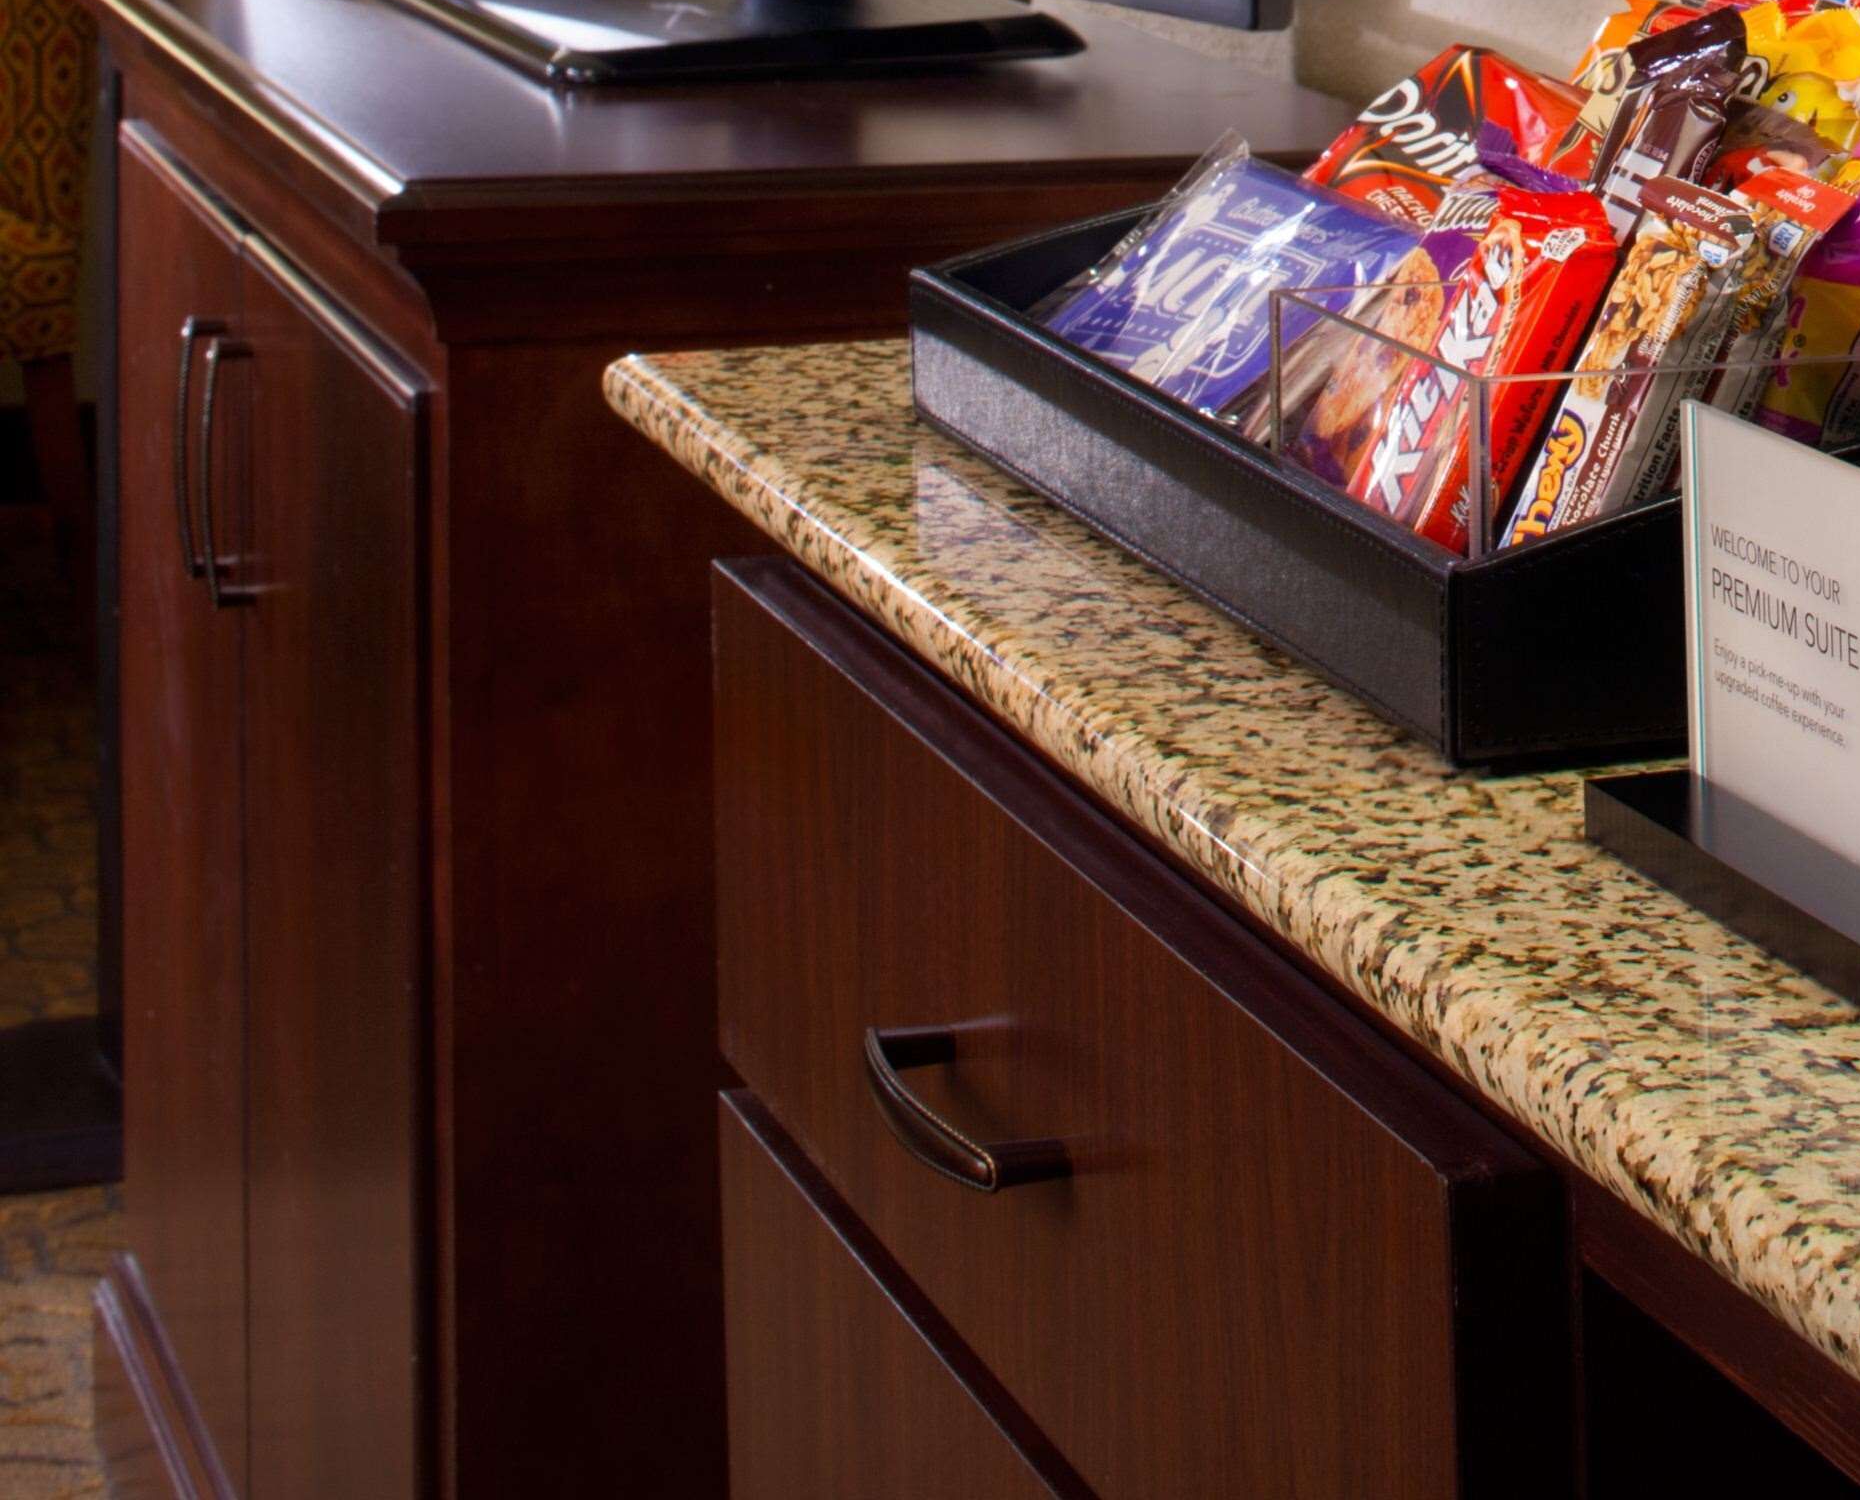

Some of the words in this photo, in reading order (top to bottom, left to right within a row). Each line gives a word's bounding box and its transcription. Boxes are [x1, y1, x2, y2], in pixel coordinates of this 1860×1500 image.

[1357, 78, 1480, 179] Dorit
[1387, 185, 1434, 228] NACHO
[1568, 462, 1601, 525] hocolate
[1597, 412, 1622, 465] Chunk
[1632, 452, 1662, 501] trition
[1655, 408, 1681, 453] Facts
[1711, 523, 1777, 576] WELCOME
[1780, 555, 1800, 585] TO
[1802, 566, 1841, 604] YOUR
[1712, 567, 1798, 640] PREMIUM
[1805, 612, 1860, 671] SUITE
[1714, 637, 1738, 669] Enjoy
[1739, 657, 1746, 669] a
[1748, 659, 1800, 701] pick-me-up
[1801, 686, 1822, 707] with
[1823, 698, 1846, 718] your
[1715, 669, 1759, 702] upgraded
[1761, 692, 1790, 719] coffee
[1791, 711, 1847, 749] experience.
